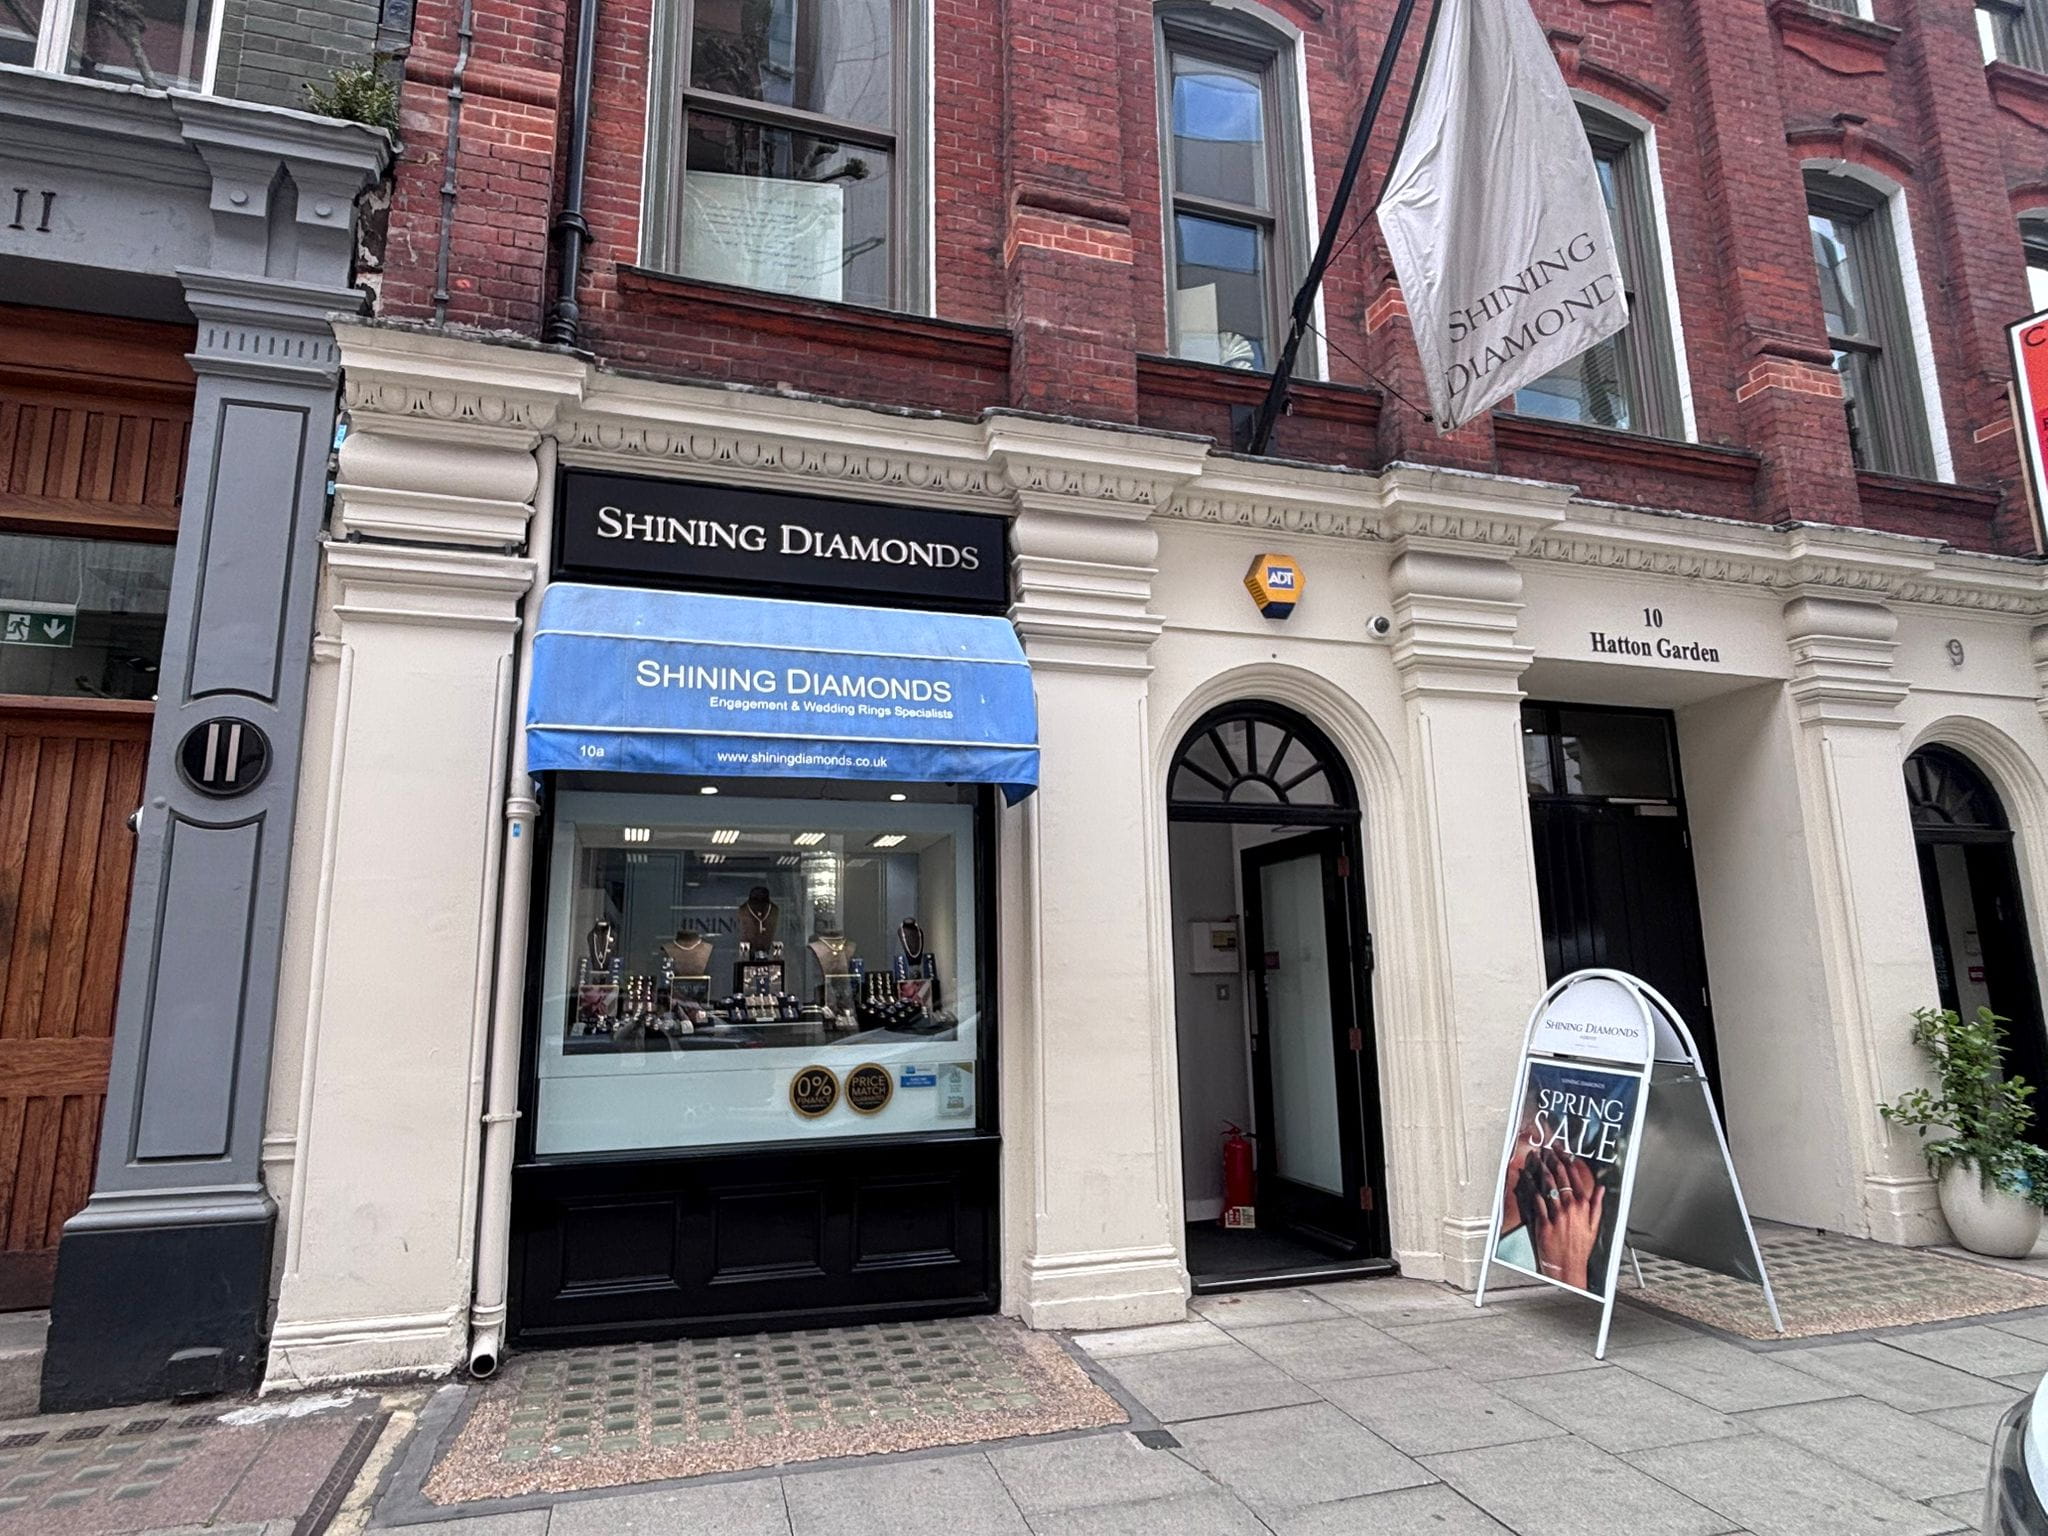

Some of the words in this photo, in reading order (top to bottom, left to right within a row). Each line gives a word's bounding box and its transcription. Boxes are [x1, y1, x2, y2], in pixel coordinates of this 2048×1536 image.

[1449, 232, 1596, 343] SHINING
[597, 506, 767, 551] SHINING
[780, 524, 979, 570] DIAMONDS
[1268, 571, 1294, 585] ADT
[1643, 608, 1663, 628] 10
[1590, 631, 1652, 657] Hatton
[1656, 638, 1720, 662] Garden
[1946, 638, 1965, 668] 9
[636, 659, 777, 692] SHINING
[787, 668, 953, 702] DIAMONDS
[709, 696, 788, 711] Engagement
[791, 700, 800, 711] &
[803, 701, 856, 715] Wedding
[858, 704, 892, 718] Rings
[894, 706, 954, 719] Specialists
[579, 745, 605, 757] 10a
[717, 752, 887, 768] www.shiningdiamonds.co.uk
[1545, 1020, 1583, 1033] SHINING
[1585, 1023, 1639, 1038] DIAMONDS
[797, 1075, 832, 1097] 0%
[851, 1086, 886, 1097] MATCH
[852, 1075, 885, 1087] PRICE
[1538, 1088, 1625, 1122] SPRING
[1528, 1109, 1622, 1164] SALE
